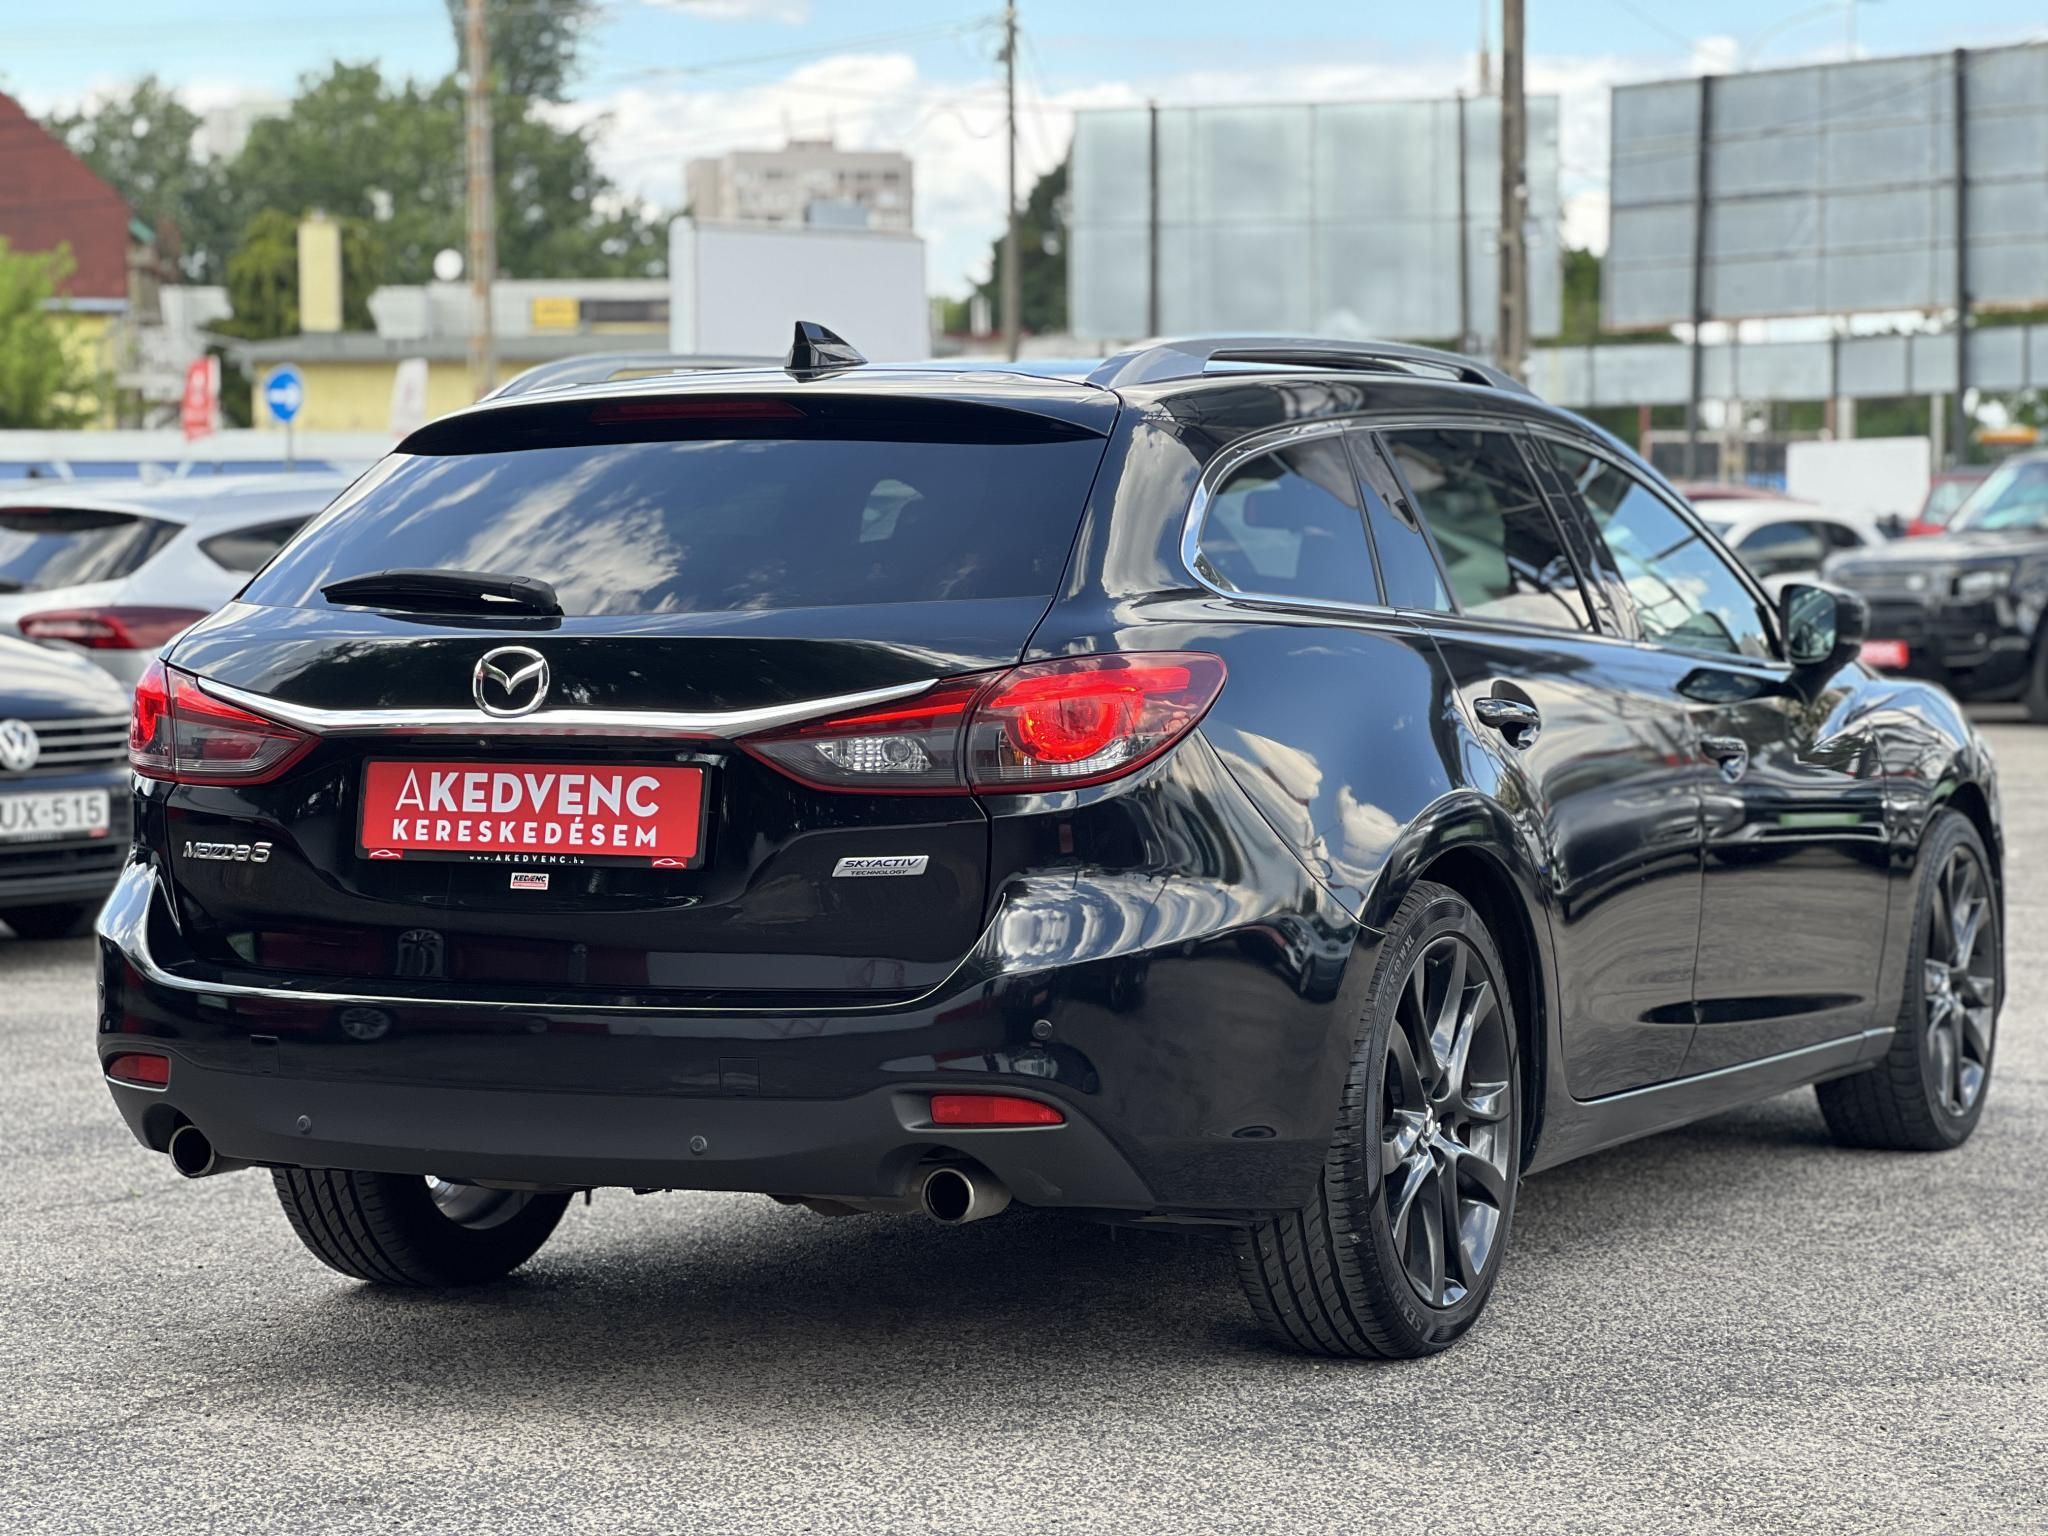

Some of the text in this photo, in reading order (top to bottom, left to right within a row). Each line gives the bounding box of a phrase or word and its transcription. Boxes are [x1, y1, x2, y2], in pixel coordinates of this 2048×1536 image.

[392, 816, 657, 848] KERESKEDÉSEM
[843, 858, 919, 868] SKYACTIV
[1404, 934, 1415, 952] XL
